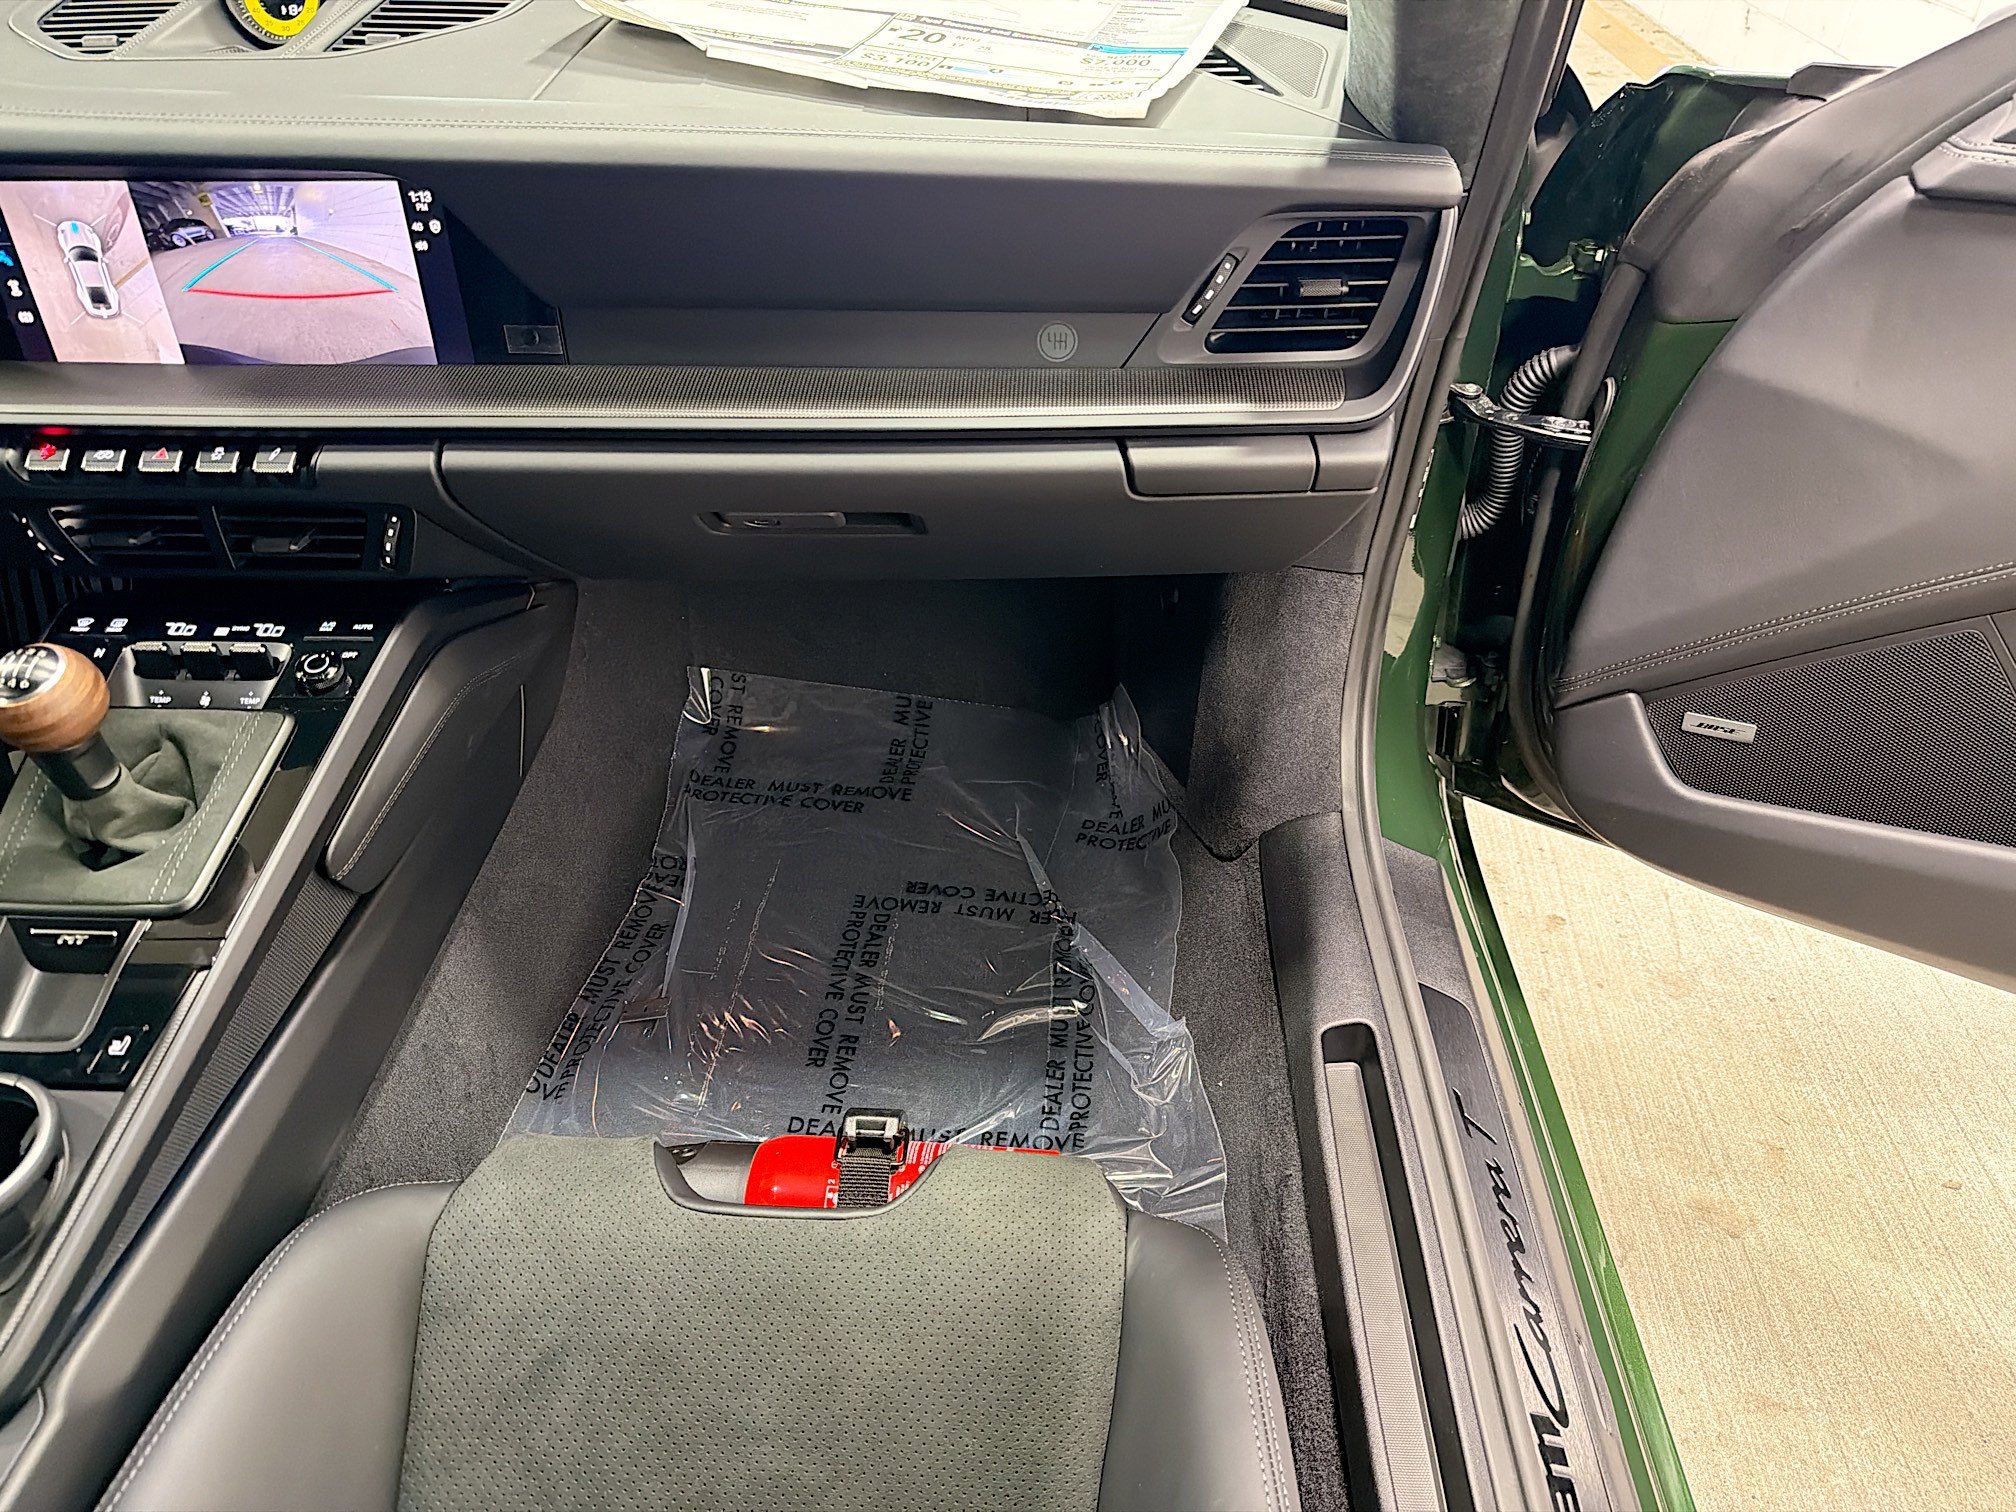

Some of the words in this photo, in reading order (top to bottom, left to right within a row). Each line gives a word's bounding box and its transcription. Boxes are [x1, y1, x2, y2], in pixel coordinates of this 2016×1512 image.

[898, 28, 947, 44] 20
[408, 190, 433, 203] 1:13
[415, 202, 429, 212] PM
[352, 623, 374, 631] AUTO
[149, 695, 172, 704] TEMP
[239, 697, 261, 706] TEMP
[714, 704, 744, 774] REMOVE
[901, 700, 933, 786] PROTECTIVE
[879, 738, 907, 784] DEALER
[689, 769, 756, 790] DEALER
[767, 779, 824, 794] MUST
[832, 783, 913, 802] REMOVE
[800, 795, 865, 814] COVER
[1081, 814, 1145, 836] DEALER
[852, 894, 943, 915] REMOVE
[905, 880, 976, 899] COVER
[953, 902, 1016, 922] MUST
[625, 922, 670, 976] COVER
[824, 910, 867, 1001] PROTECTIVE
[859, 912, 891, 968] DEALER
[581, 956, 621, 1006] MUST
[845, 972, 874, 1025] MUST
[805, 1008, 839, 1068] COVER
[821, 1033, 860, 1115] REMOVE
[1040, 1059, 1066, 1131] DEALER
[1451, 1086, 1498, 1145] T
[980, 1130, 1086, 1151] REMOVE
[1484, 1156, 1571, 1430] Carrera
